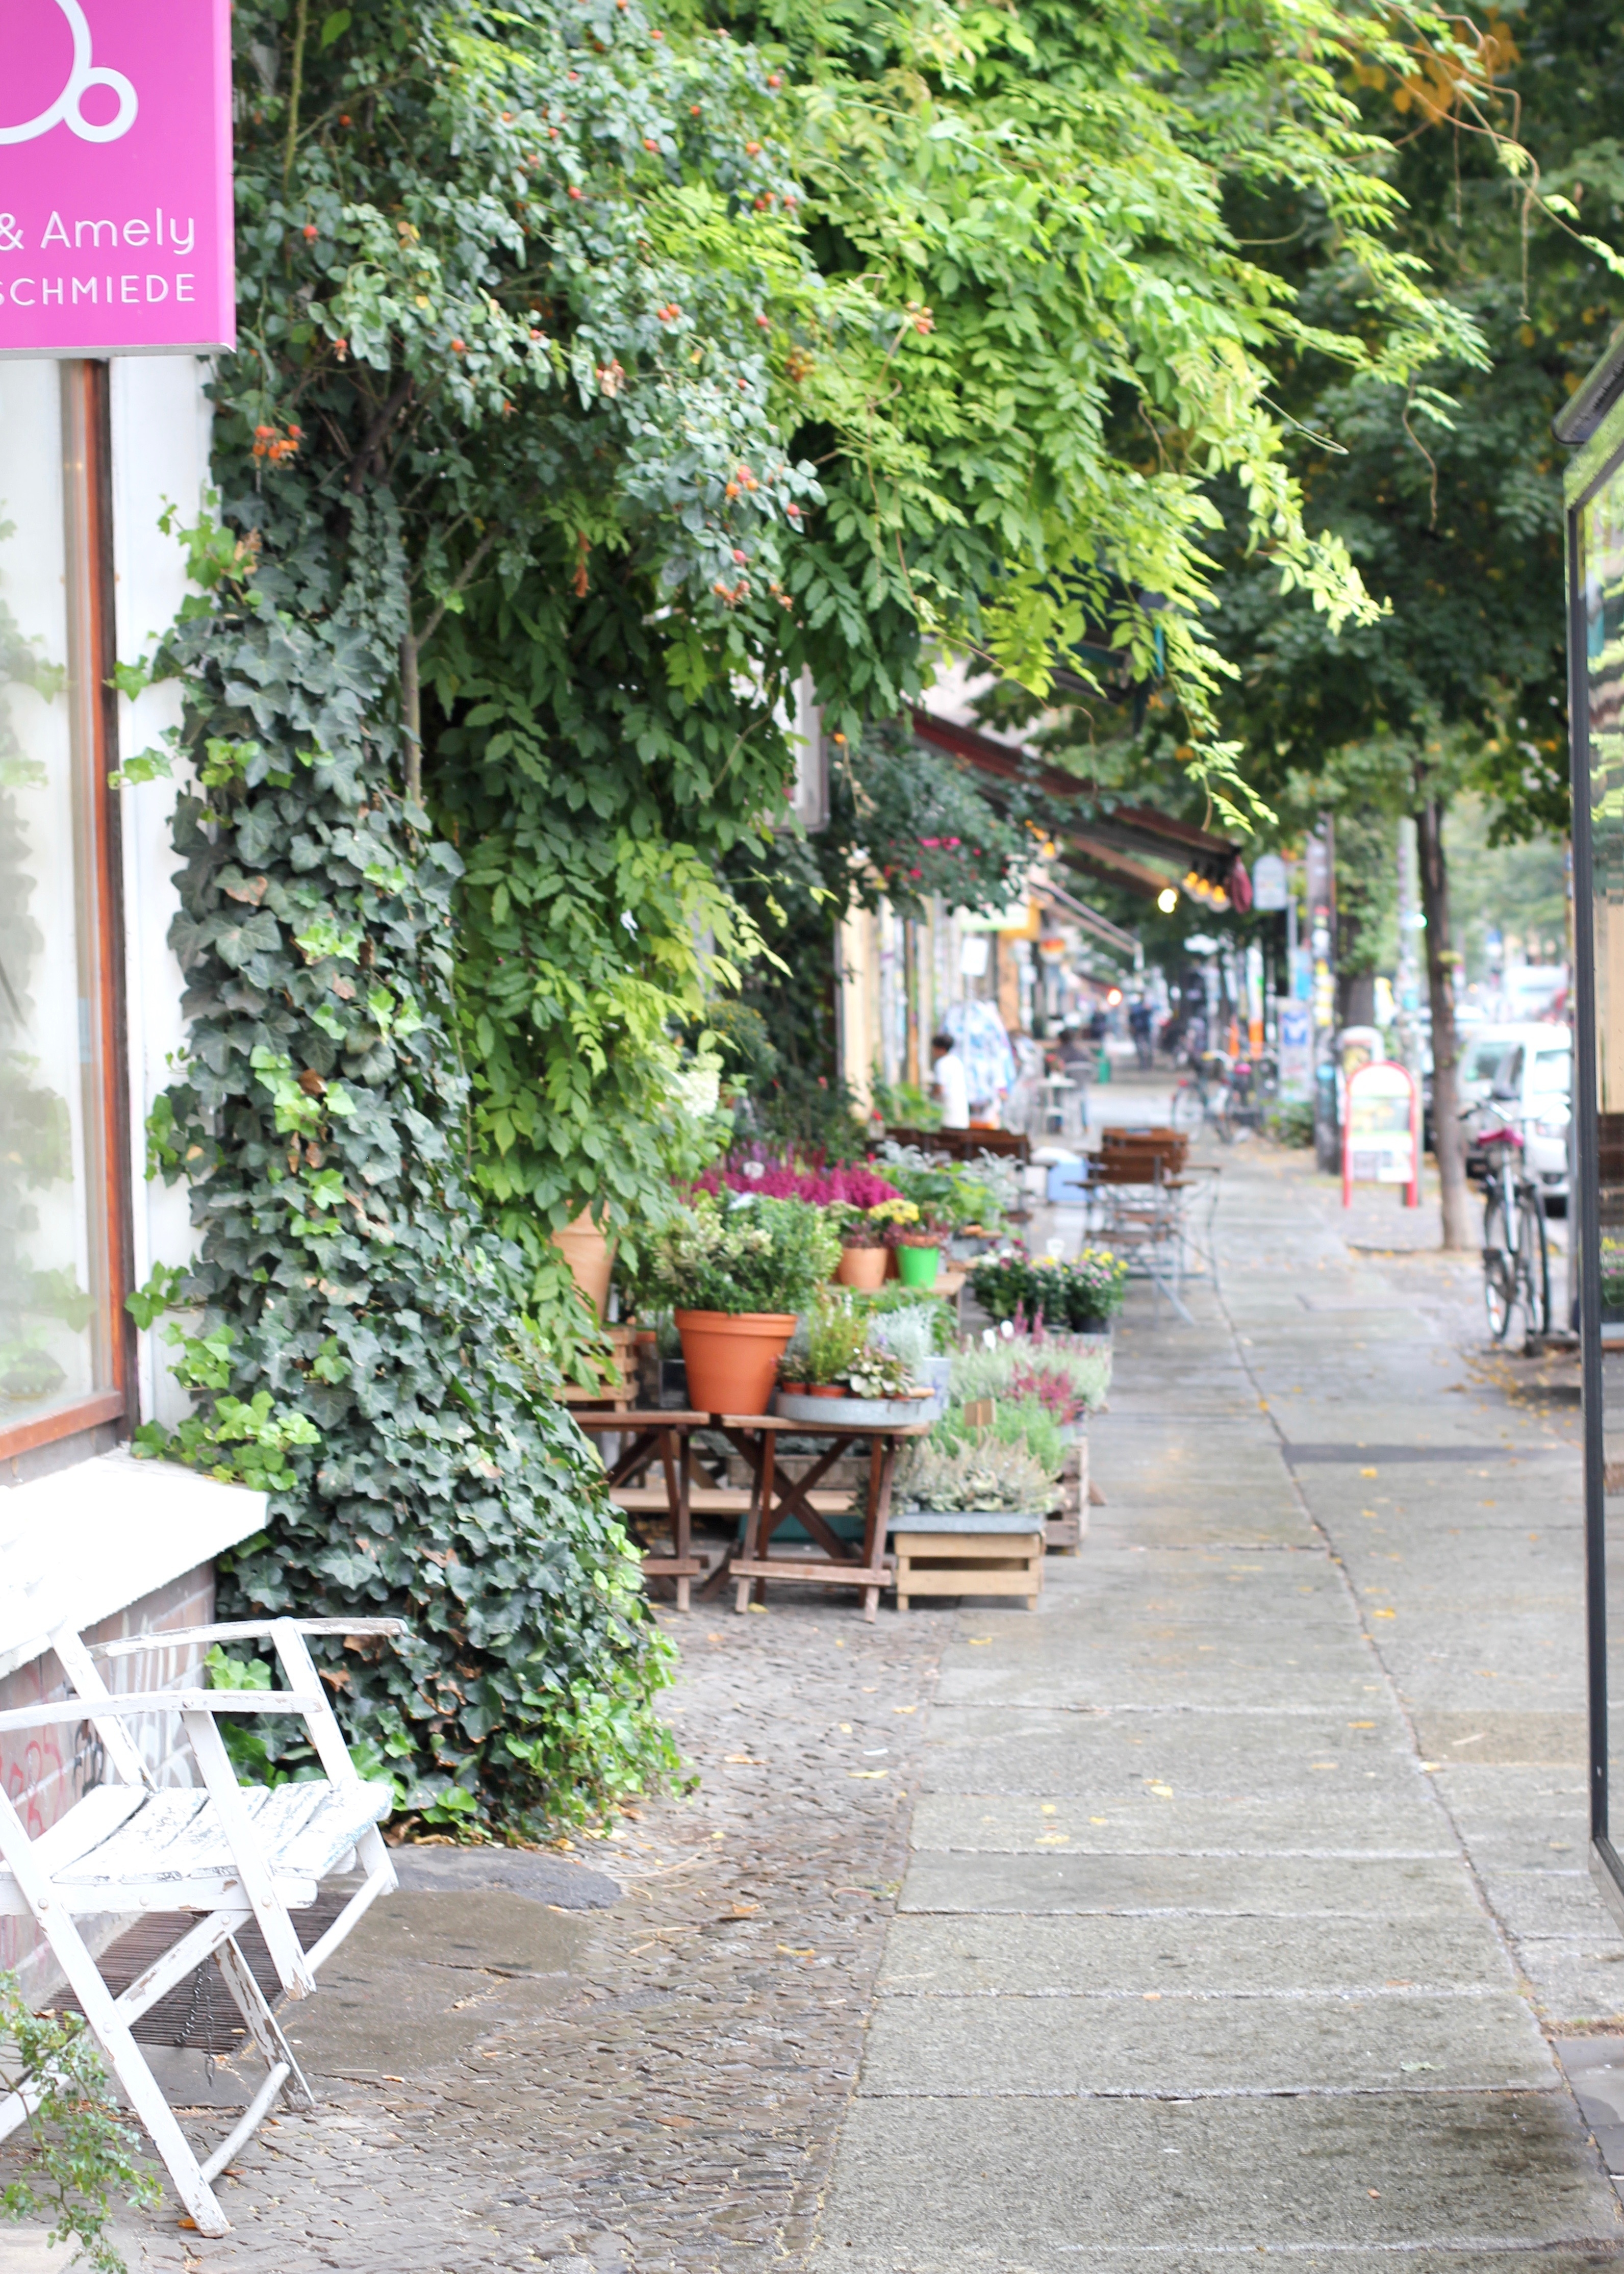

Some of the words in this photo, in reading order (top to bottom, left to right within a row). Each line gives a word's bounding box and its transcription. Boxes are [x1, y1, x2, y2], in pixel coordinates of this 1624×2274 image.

[0, 213, 24, 251] &
[40, 207, 195, 255] Amely
[0, 273, 195, 306] CHMIEDE
